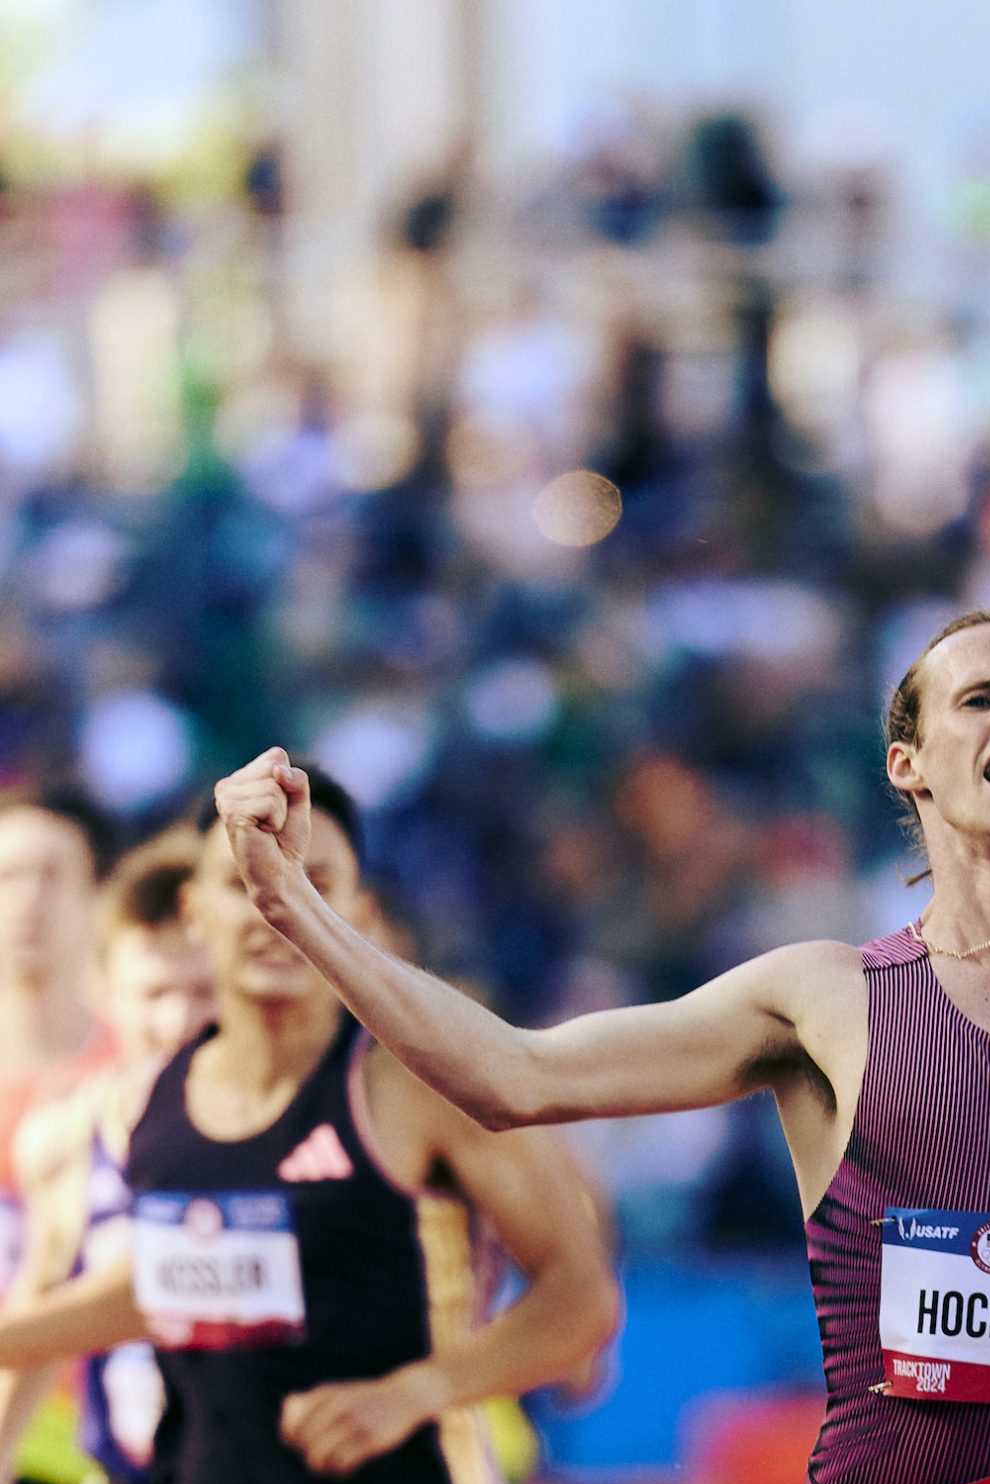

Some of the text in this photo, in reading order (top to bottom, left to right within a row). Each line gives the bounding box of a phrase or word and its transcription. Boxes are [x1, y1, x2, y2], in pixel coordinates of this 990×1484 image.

[915, 1225, 959, 1240] USATF
[893, 1359, 951, 1380] TRACKTOWN
[916, 1376, 946, 1393] 2024
